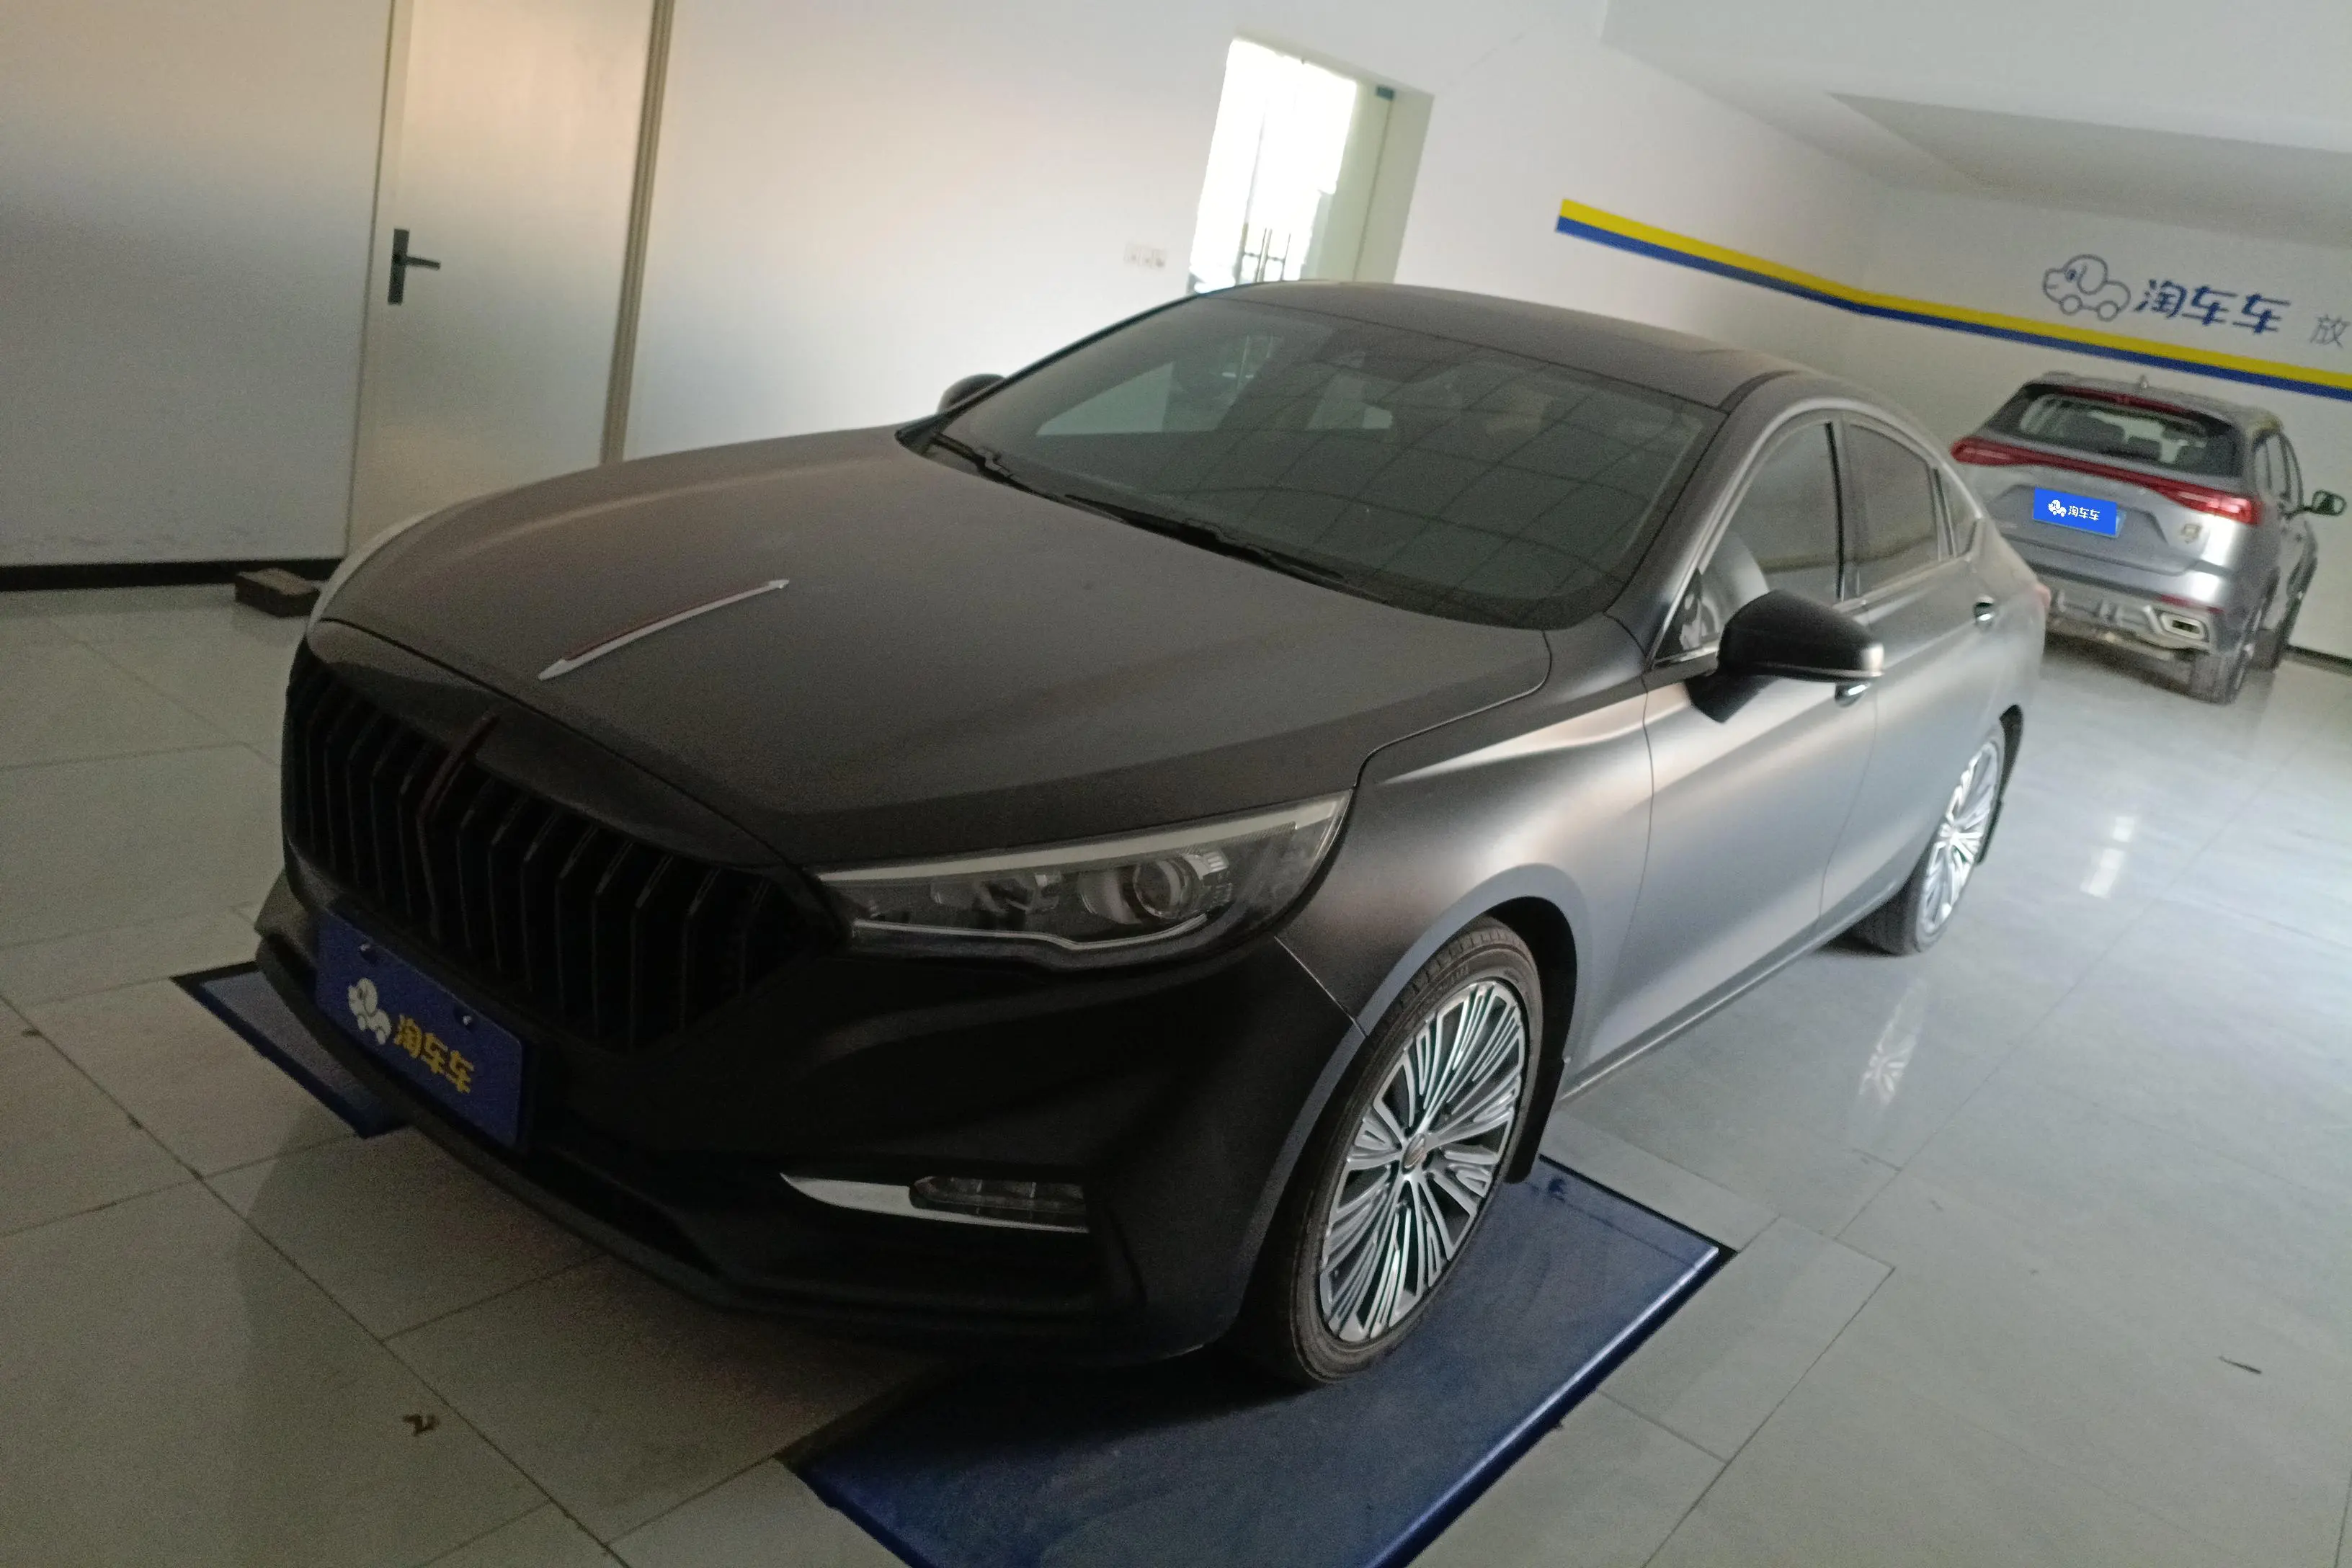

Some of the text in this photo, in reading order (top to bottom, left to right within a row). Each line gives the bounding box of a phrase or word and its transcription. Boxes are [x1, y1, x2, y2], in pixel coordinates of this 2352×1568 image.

[2134, 279, 2351, 349] 淘车车 放
[394, 1015, 474, 1093] 淘车车
